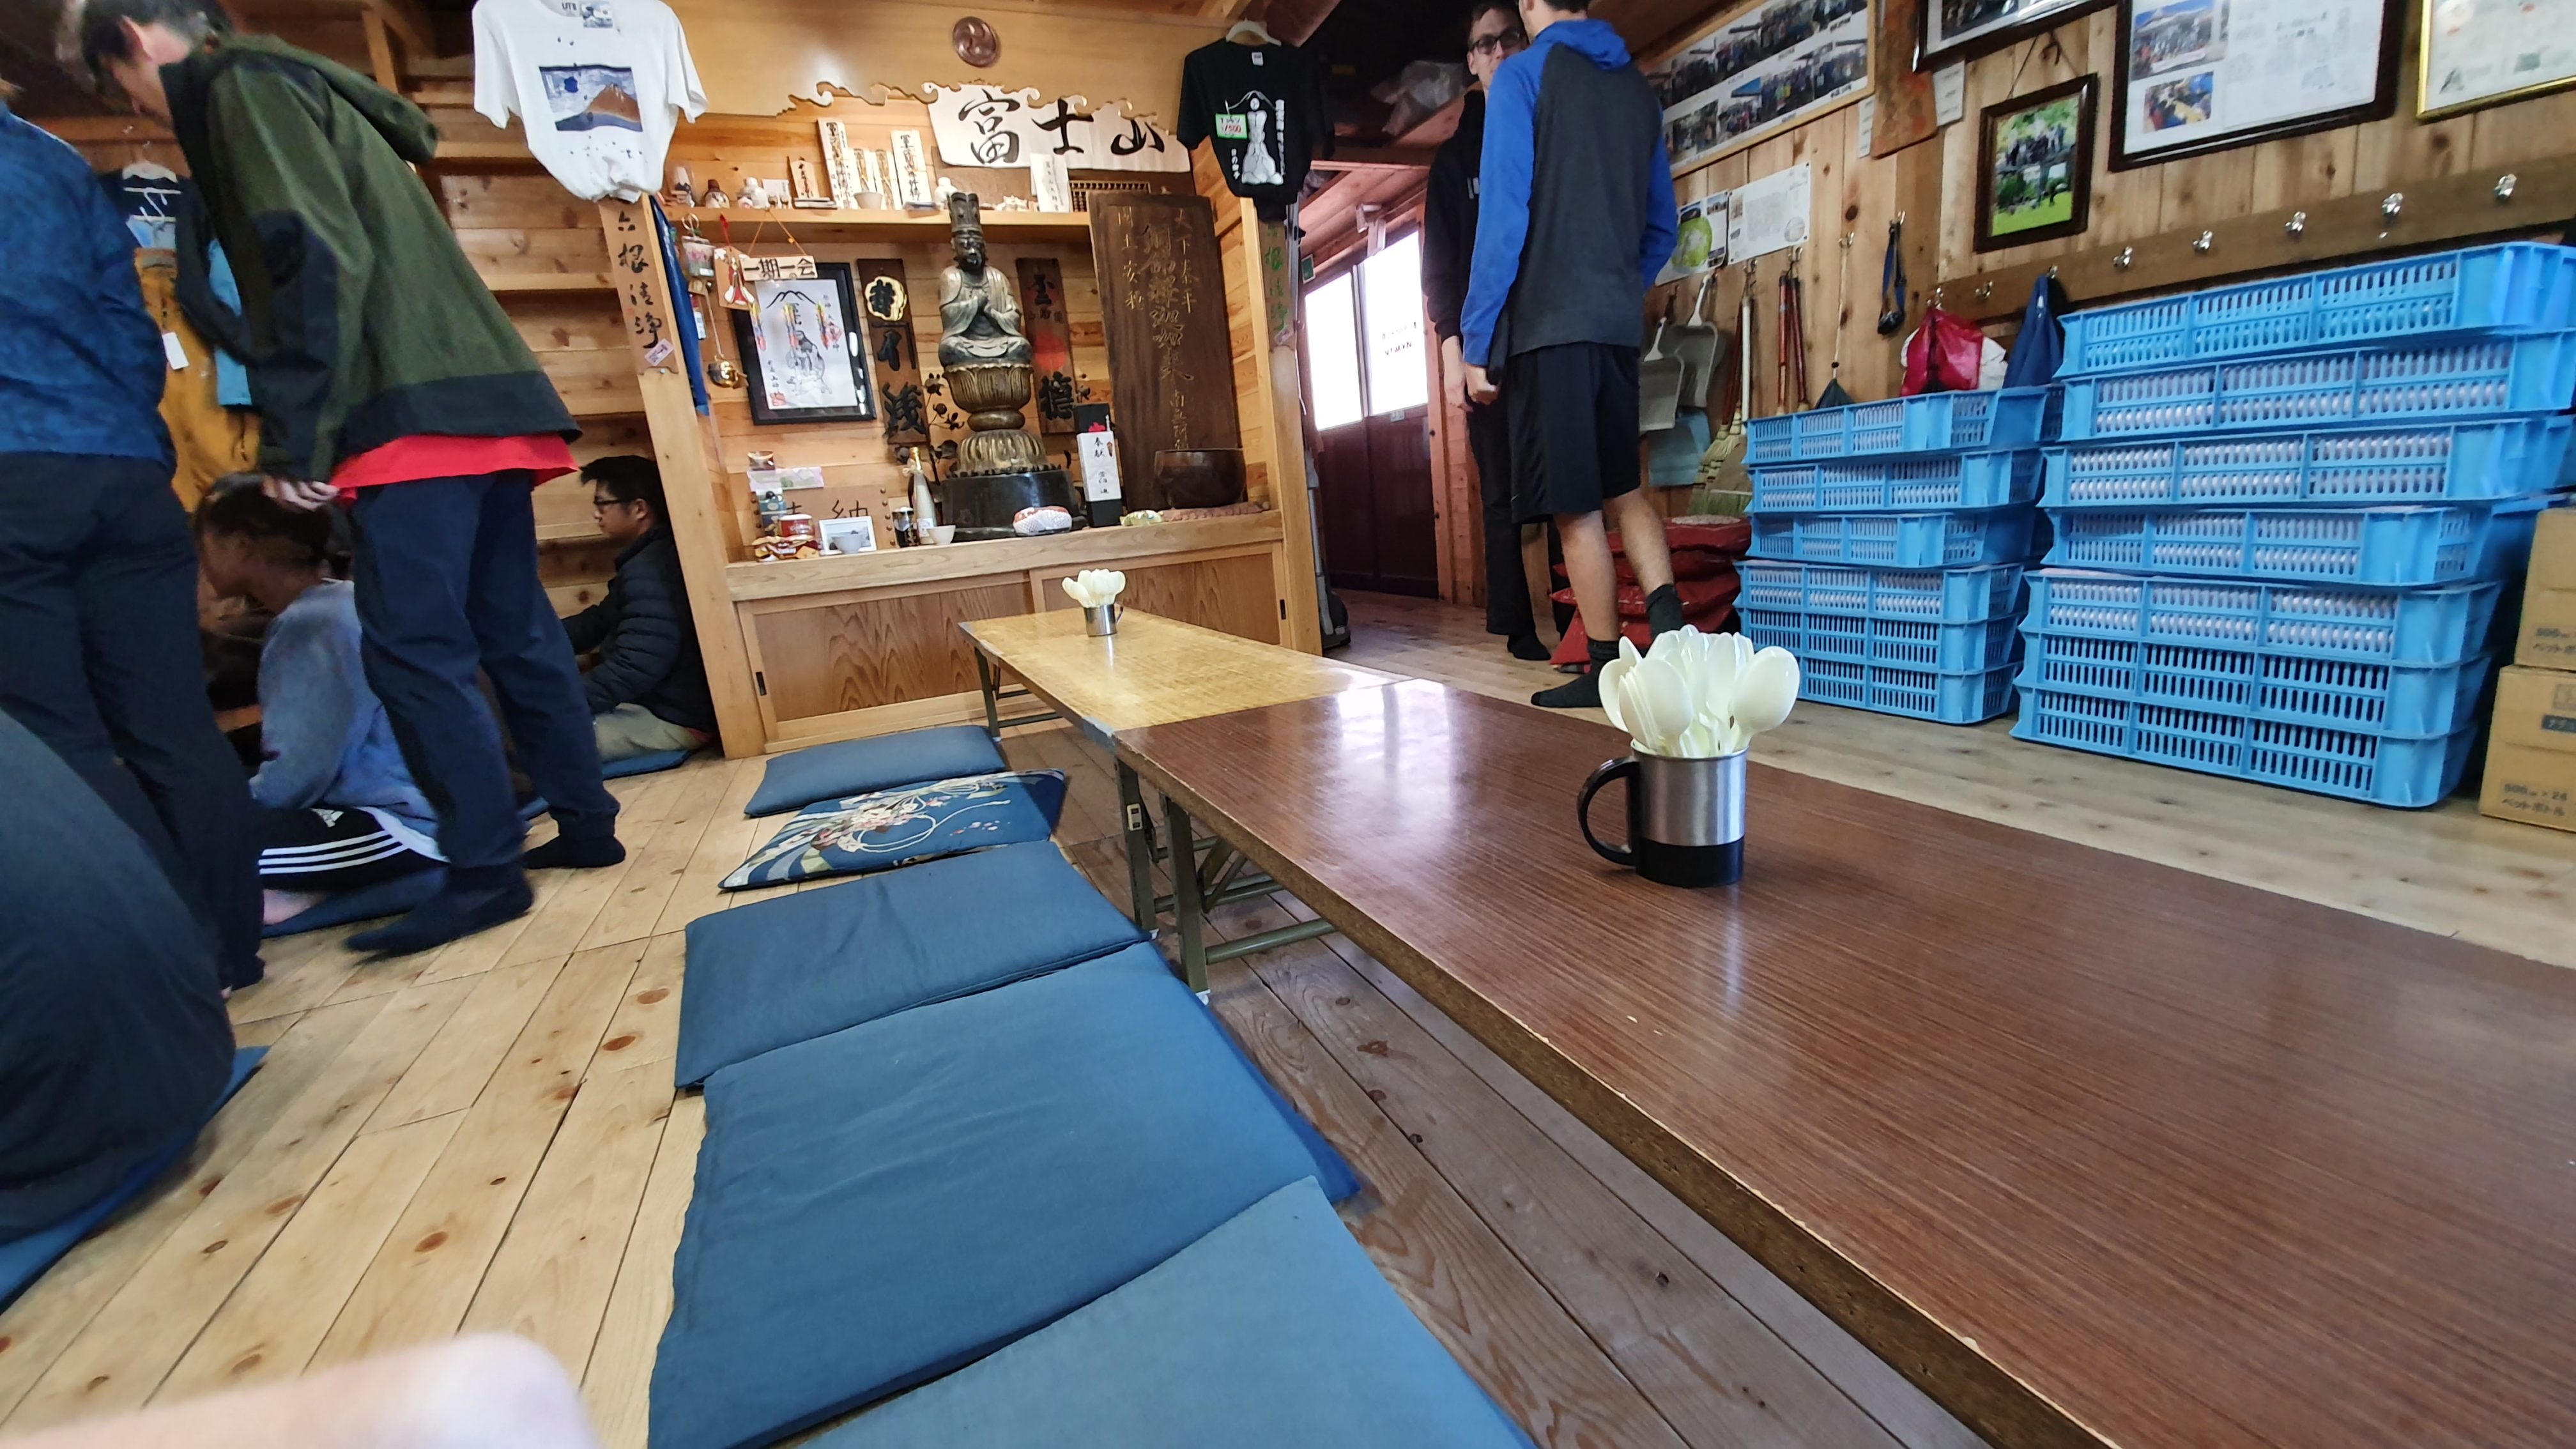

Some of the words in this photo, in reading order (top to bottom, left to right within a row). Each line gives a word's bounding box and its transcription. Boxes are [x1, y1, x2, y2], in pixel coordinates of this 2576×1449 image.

[958, 88, 1165, 165] 富士山
[744, 257, 816, 278] 一期一会
